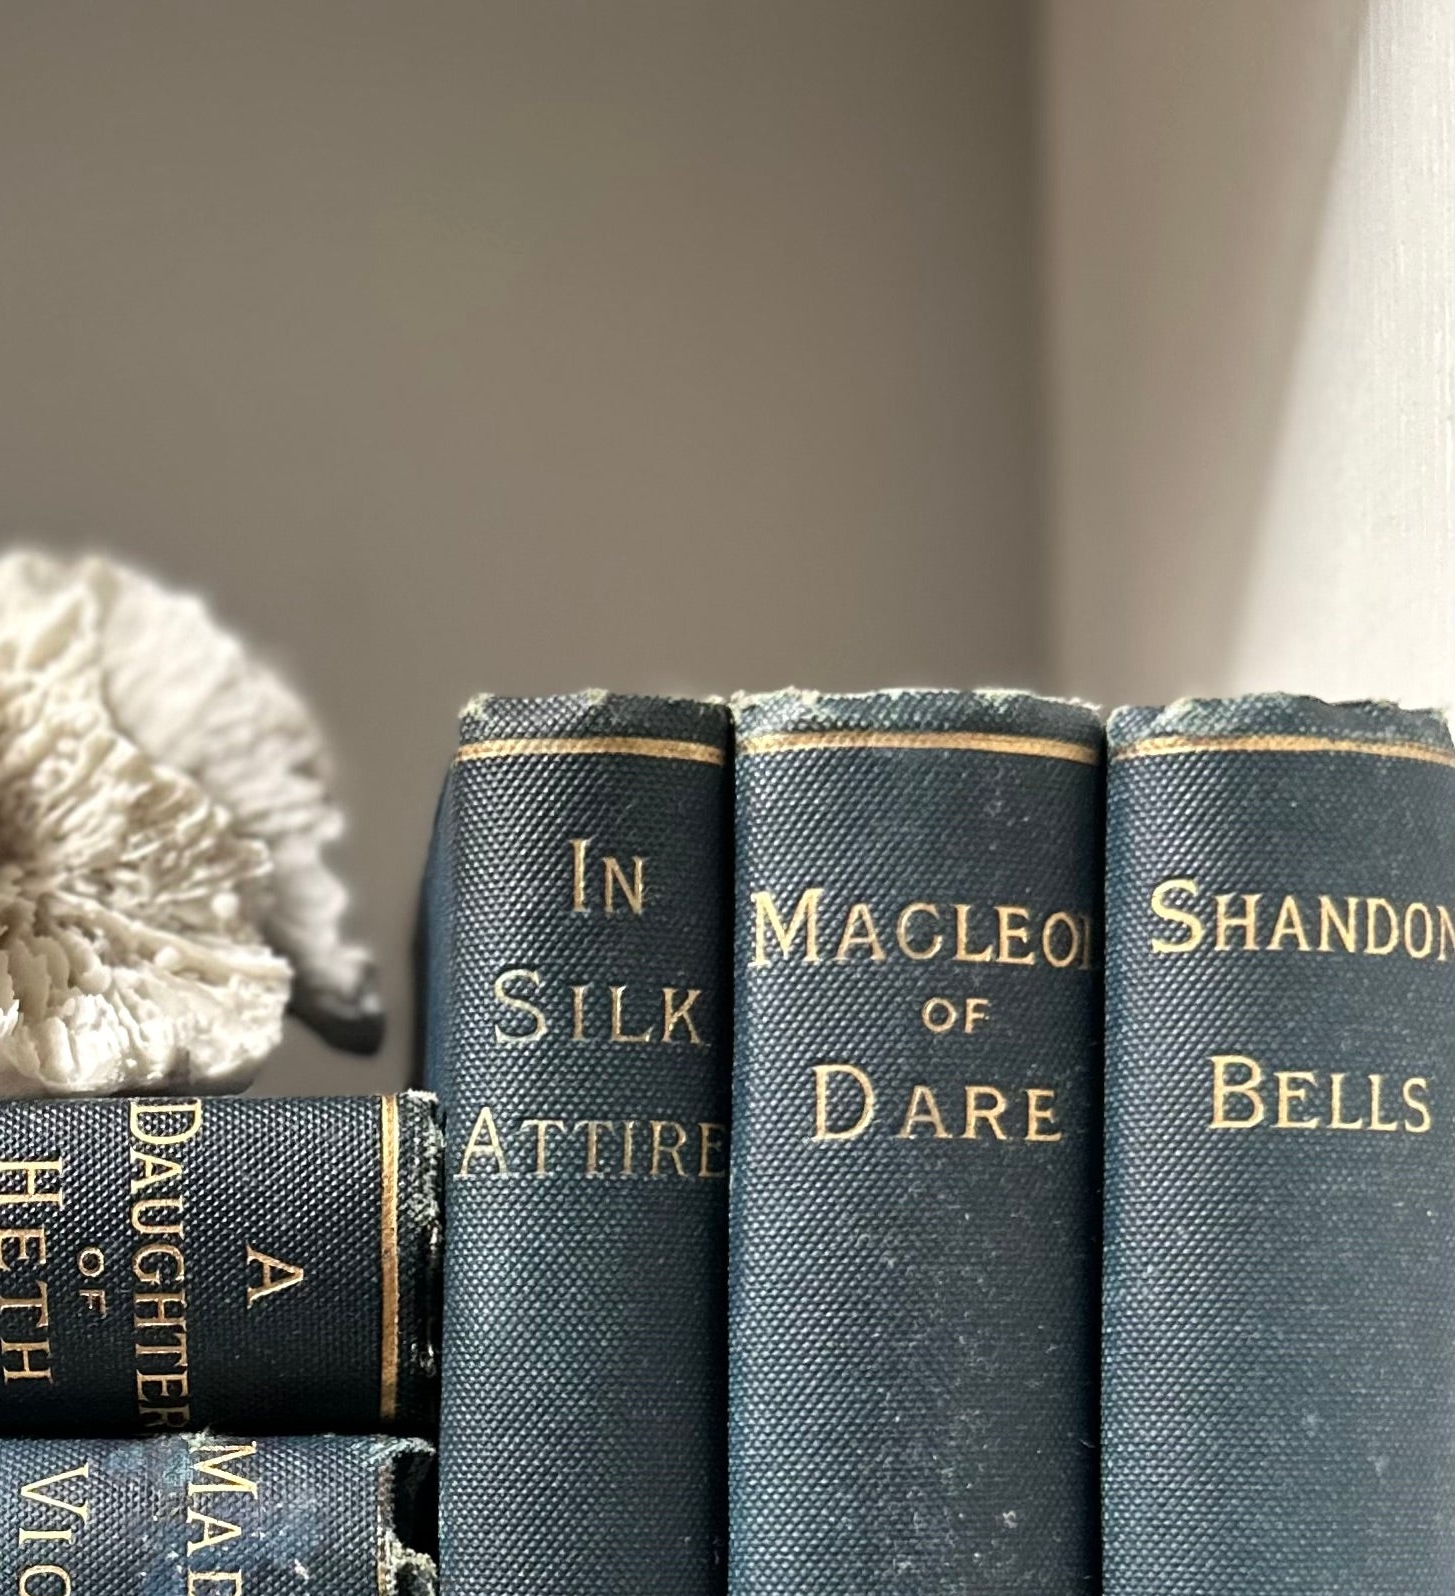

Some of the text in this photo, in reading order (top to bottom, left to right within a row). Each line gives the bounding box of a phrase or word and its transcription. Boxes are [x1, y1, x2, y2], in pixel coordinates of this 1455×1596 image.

[493, 969, 709, 1048] SILK
[922, 996, 990, 1034] OF
[812, 1063, 1064, 1143] DARE
[1207, 1055, 1431, 1137] BELLS
[455, 1104, 726, 1180] ATTIRE
[78, 1248, 107, 1317] OF
[246, 1245, 304, 1302] A
